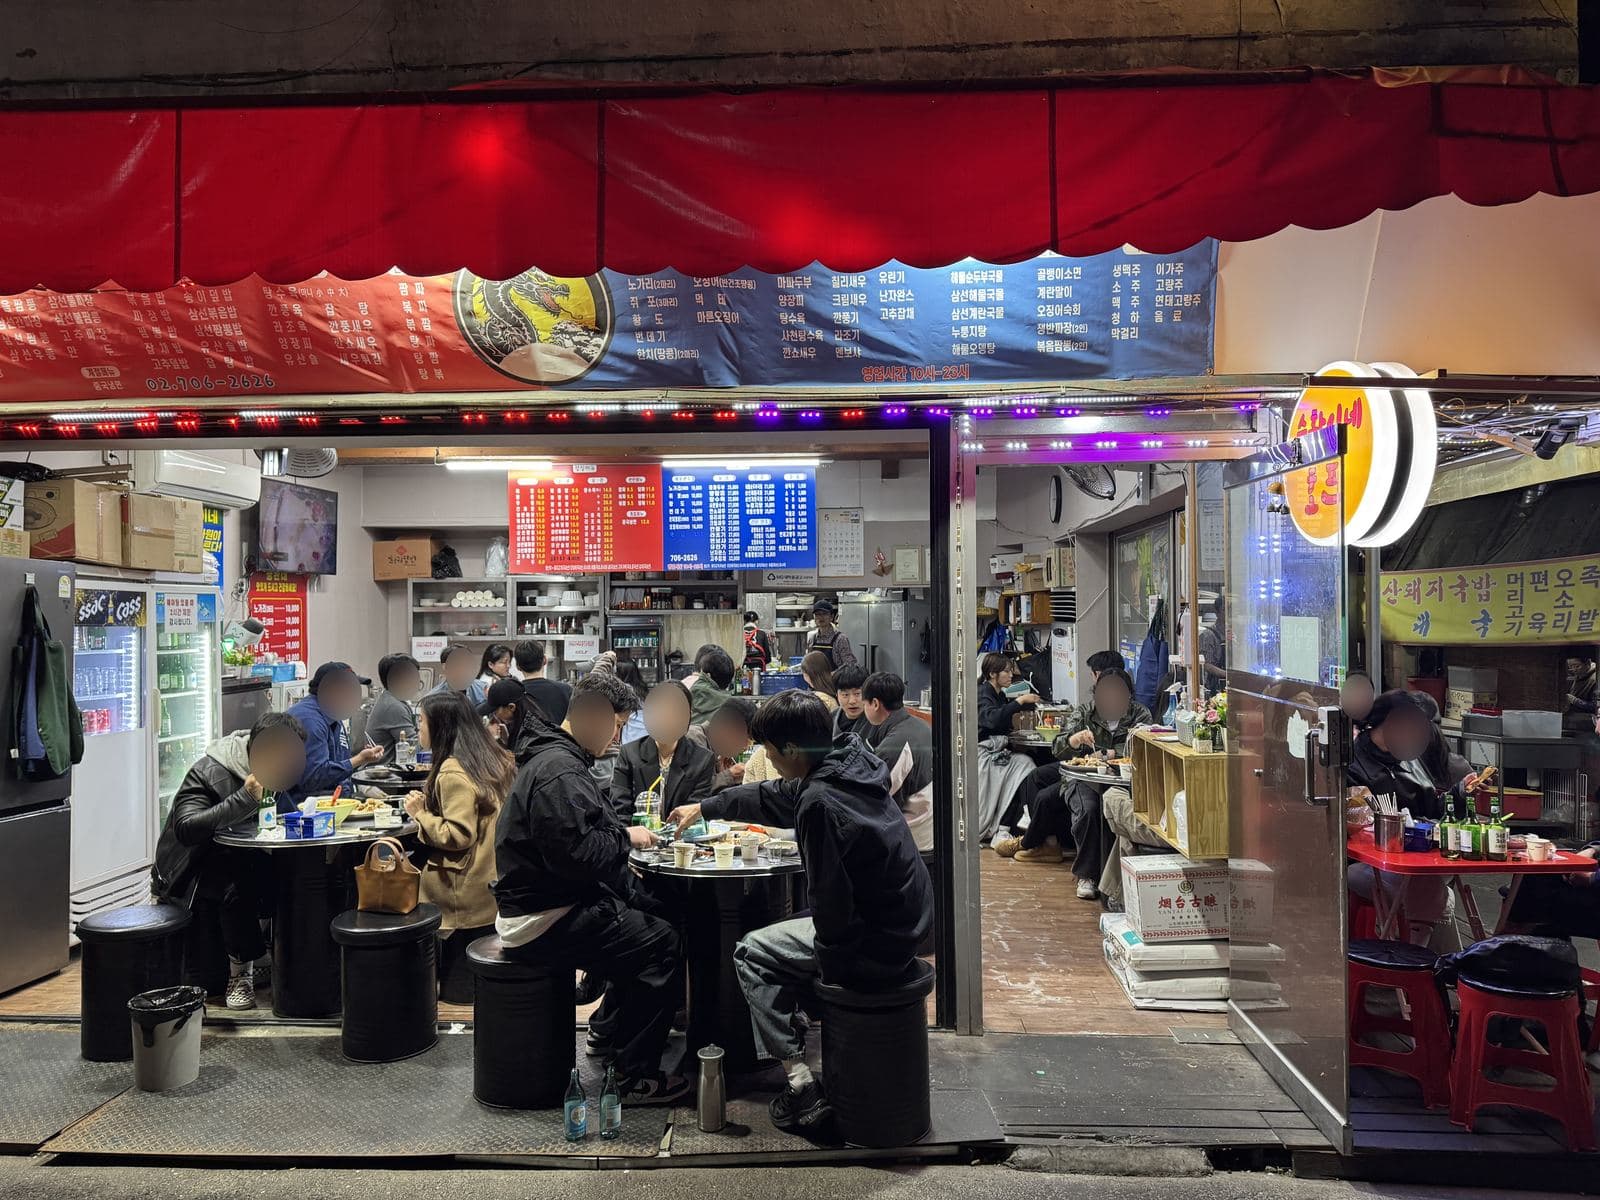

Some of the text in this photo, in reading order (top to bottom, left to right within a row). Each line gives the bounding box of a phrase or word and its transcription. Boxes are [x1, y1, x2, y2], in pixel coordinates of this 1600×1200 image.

[1037, 267, 1082, 280] 골뱅이소면
[1112, 264, 1140, 277] 생맥주
[1156, 263, 1184, 275] 이가주
[777, 276, 812, 288] 마파두부
[832, 275, 866, 288] 칠리새우
[879, 271, 905, 283] 유린기
[1155, 279, 1184, 291] 고량주
[879, 289, 915, 302] 난자완스
[1037, 286, 1073, 299] 계란말이
[778, 295, 804, 307] 양장피
[832, 294, 867, 306] 크림새우
[1155, 294, 1201, 307] 연태고량주
[697, 311, 740, 324] 마른오징어
[780, 313, 806, 325] 탕수육
[832, 312, 859, 324] 깐풍기
[880, 307, 915, 320] 고추잡채
[1154, 310, 1182, 323] 음료
[635, 330, 666, 343] 번데기
[782, 330, 824, 342] 사천탕수육
[951, 325, 987, 338] 누룽지탕
[1111, 327, 1139, 340] 막걸리
[861, 362, 970, 382] 영업시간 10시-23시
[146, 374, 276, 392] 02.706-2626
[1382, 573, 1497, 606] 산돼지국밥
[1503, 571, 1526, 637] 머리고기
[1527, 569, 1549, 634] 편육
[1551, 567, 1576, 633] 오소리
